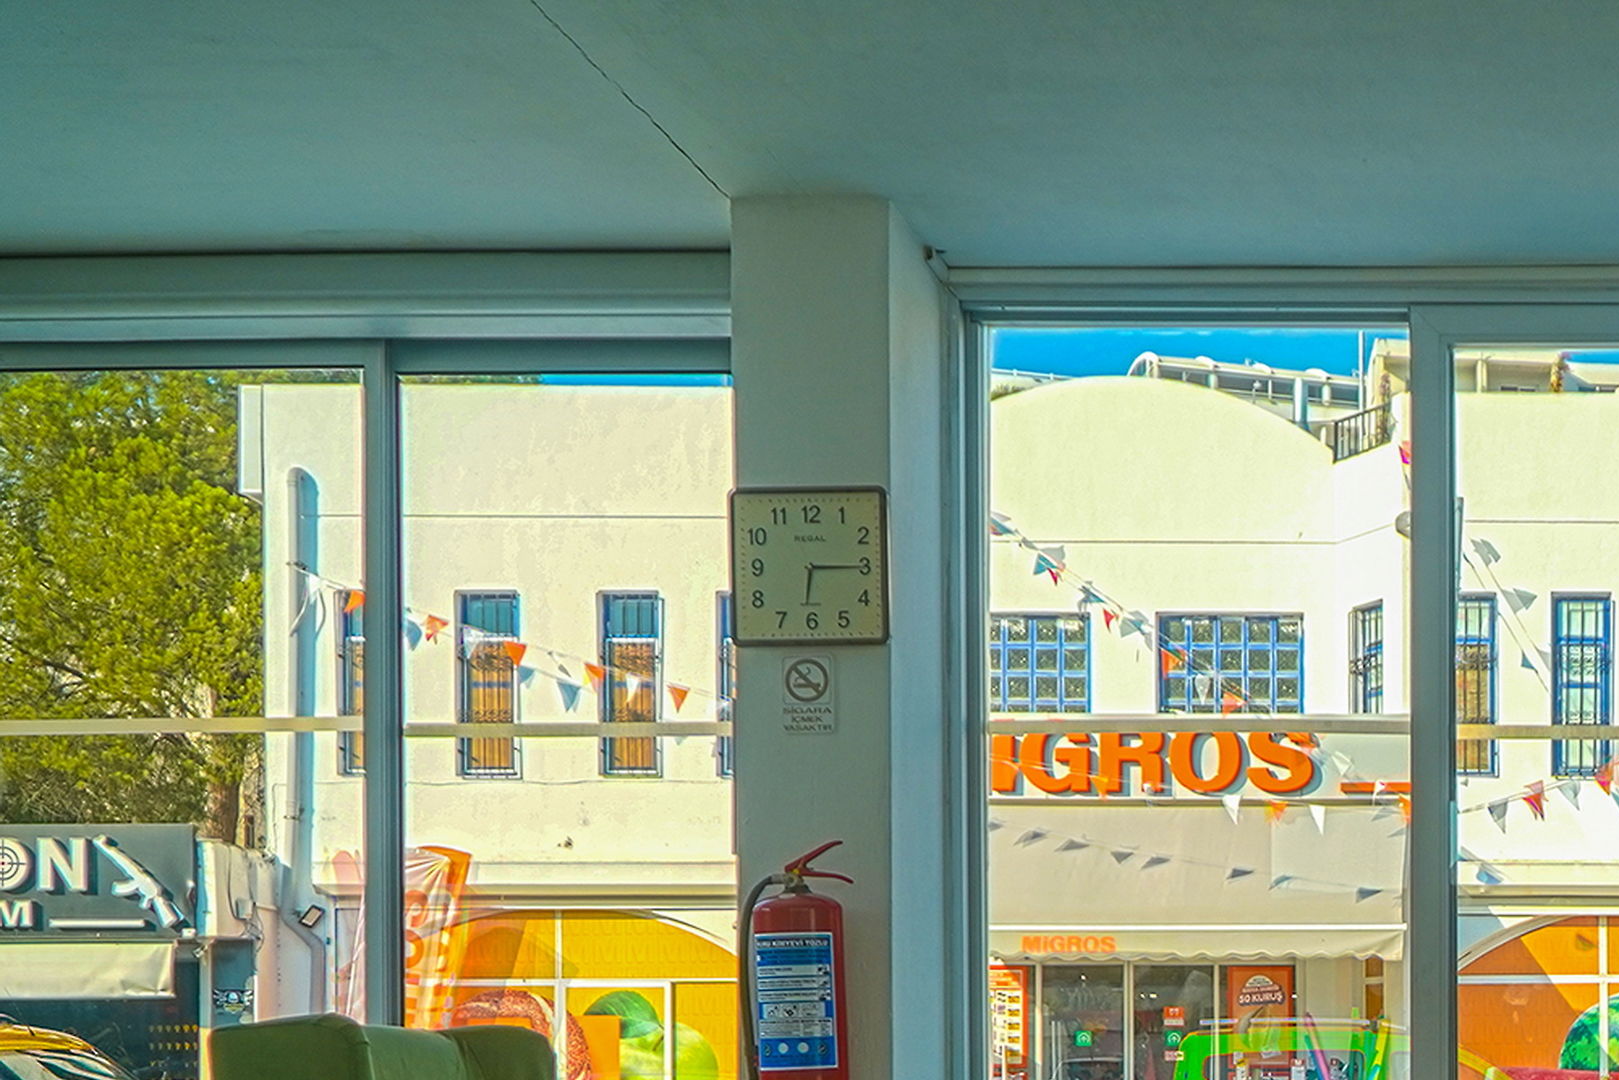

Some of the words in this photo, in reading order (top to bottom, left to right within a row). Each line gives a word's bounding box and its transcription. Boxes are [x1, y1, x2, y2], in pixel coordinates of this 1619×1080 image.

[771, 507, 787, 525] 11
[801, 505, 821, 524] 12
[838, 506, 846, 524] 1
[747, 528, 767, 546] 10
[794, 535, 826, 543] REGAL
[857, 527, 870, 545] 2
[751, 558, 764, 577] 9
[858, 557, 871, 576] 3
[752, 590, 765, 609] 8
[857, 589, 869, 607] 4
[775, 611, 788, 629] 7
[806, 612, 819, 630] 6
[837, 610, 850, 629] 5
